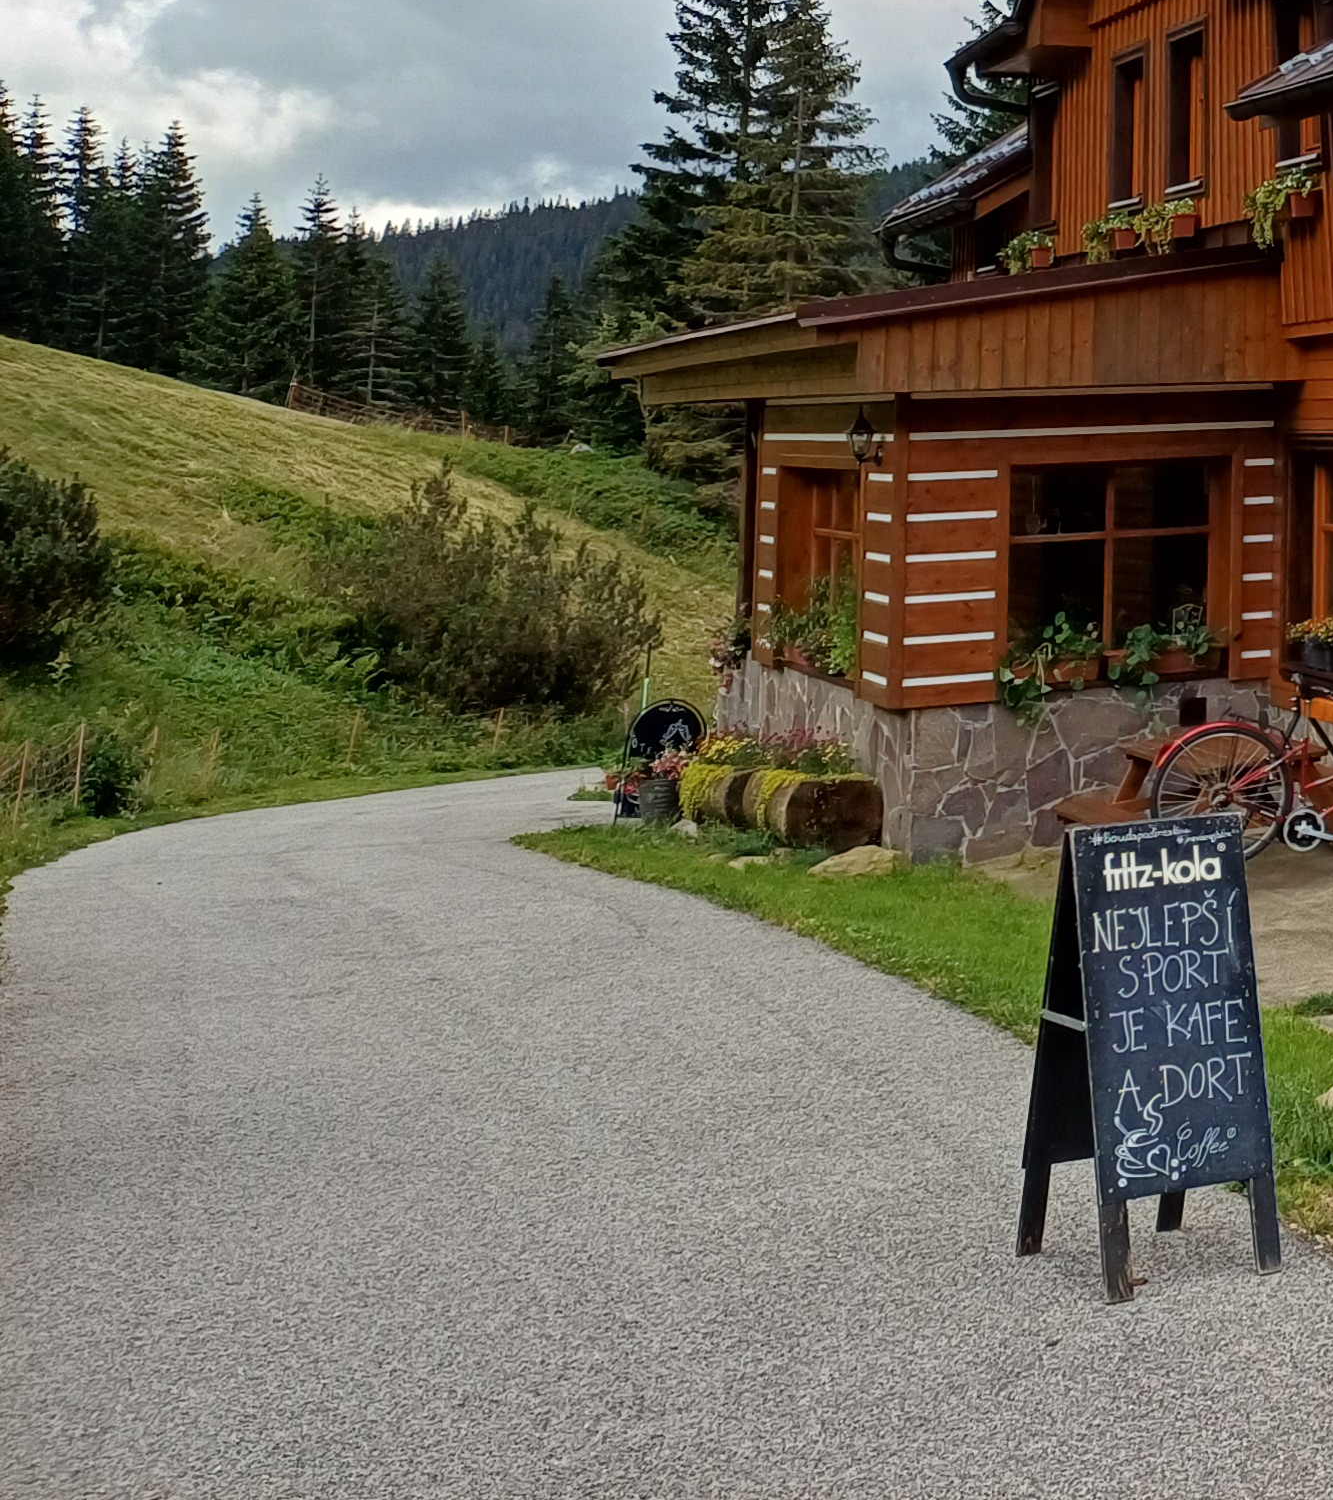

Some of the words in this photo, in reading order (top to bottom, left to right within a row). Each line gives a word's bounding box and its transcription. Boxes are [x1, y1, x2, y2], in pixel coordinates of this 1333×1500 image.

[1103, 845, 1222, 892] fritz-kola
[1092, 888, 1239, 953] NEJLEPŠÍ
[1118, 947, 1229, 998] SPORT
[1109, 1007, 1147, 1053] JE
[1165, 999, 1248, 1047] KAFE
[1114, 1069, 1143, 1114] A
[1159, 1051, 1252, 1109] DORT
[1176, 1121, 1230, 1168] Coffee
